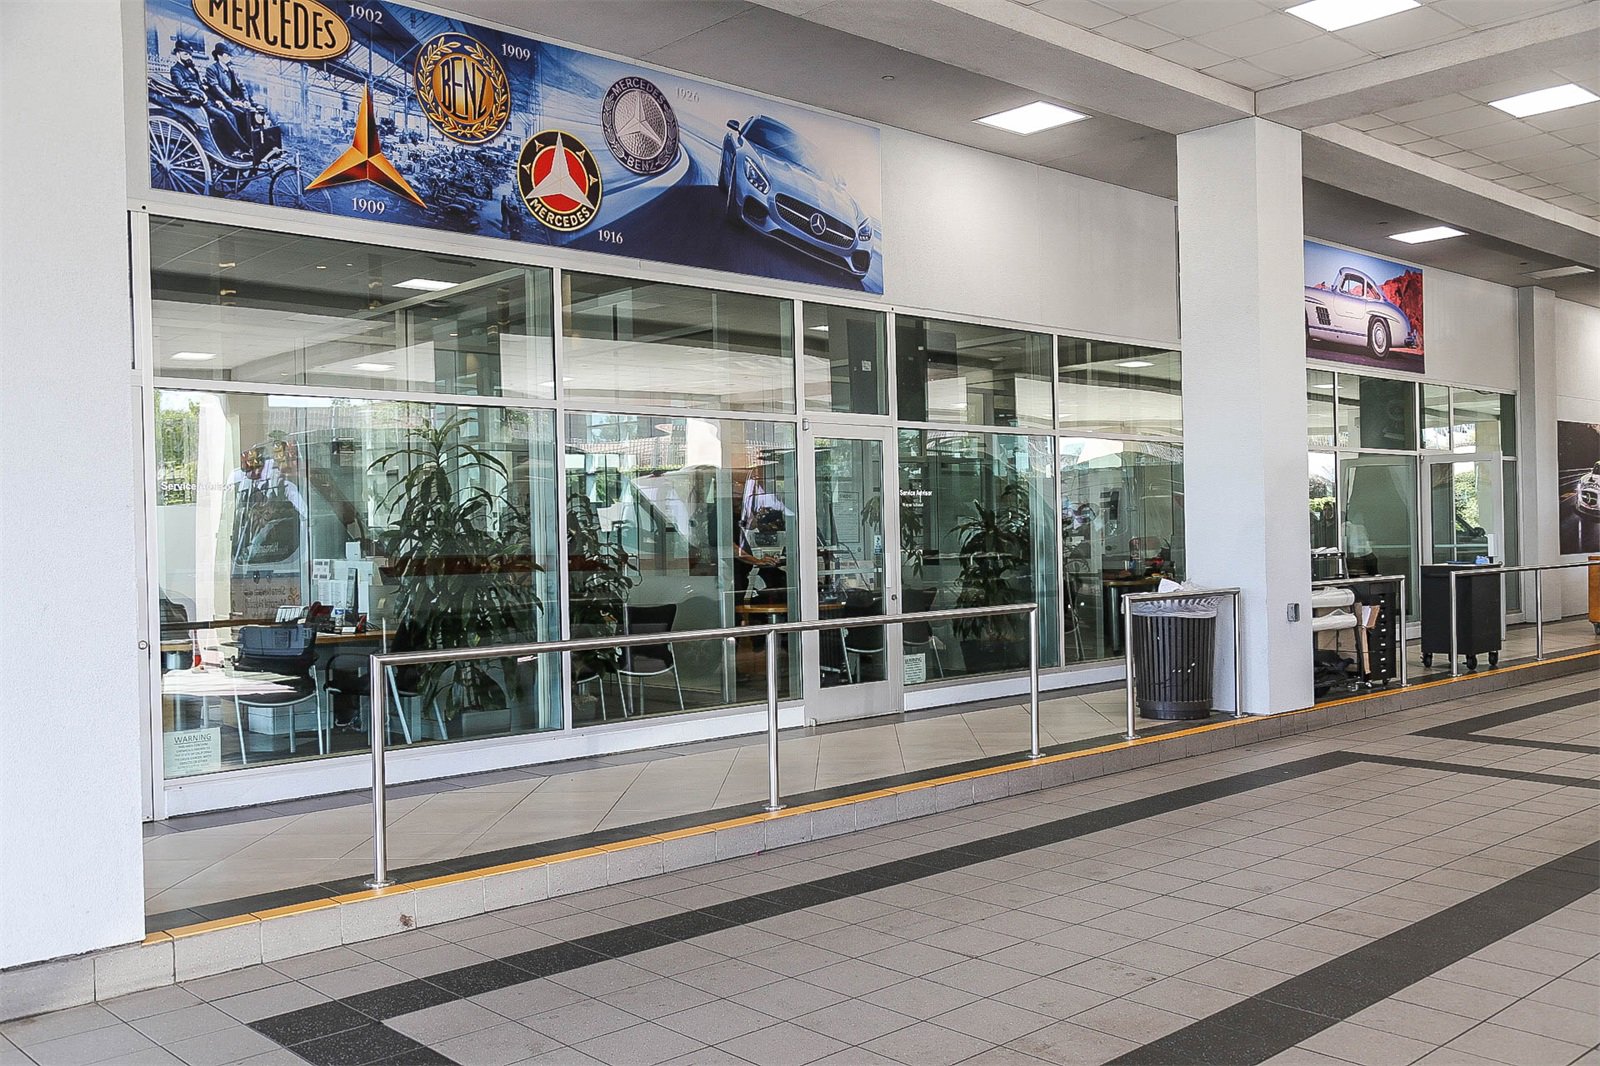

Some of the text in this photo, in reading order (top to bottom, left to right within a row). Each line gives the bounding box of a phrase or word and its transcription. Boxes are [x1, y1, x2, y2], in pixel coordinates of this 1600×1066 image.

[348, 4, 384, 25] 1902
[207, 0, 338, 50] MERCEDES
[501, 43, 531, 61] 1909
[439, 56, 488, 121] BENZ
[611, 78, 665, 105] MERCEDES
[675, 86, 701, 104] 1926
[626, 157, 658, 171] BENZ
[351, 197, 386, 215] 1909
[529, 198, 591, 227] MERCEDES
[598, 228, 624, 245] 1916
[160, 481, 197, 492] Service
[899, 489, 933, 497] Service Advisor
[174, 733, 212, 743] WARNING
